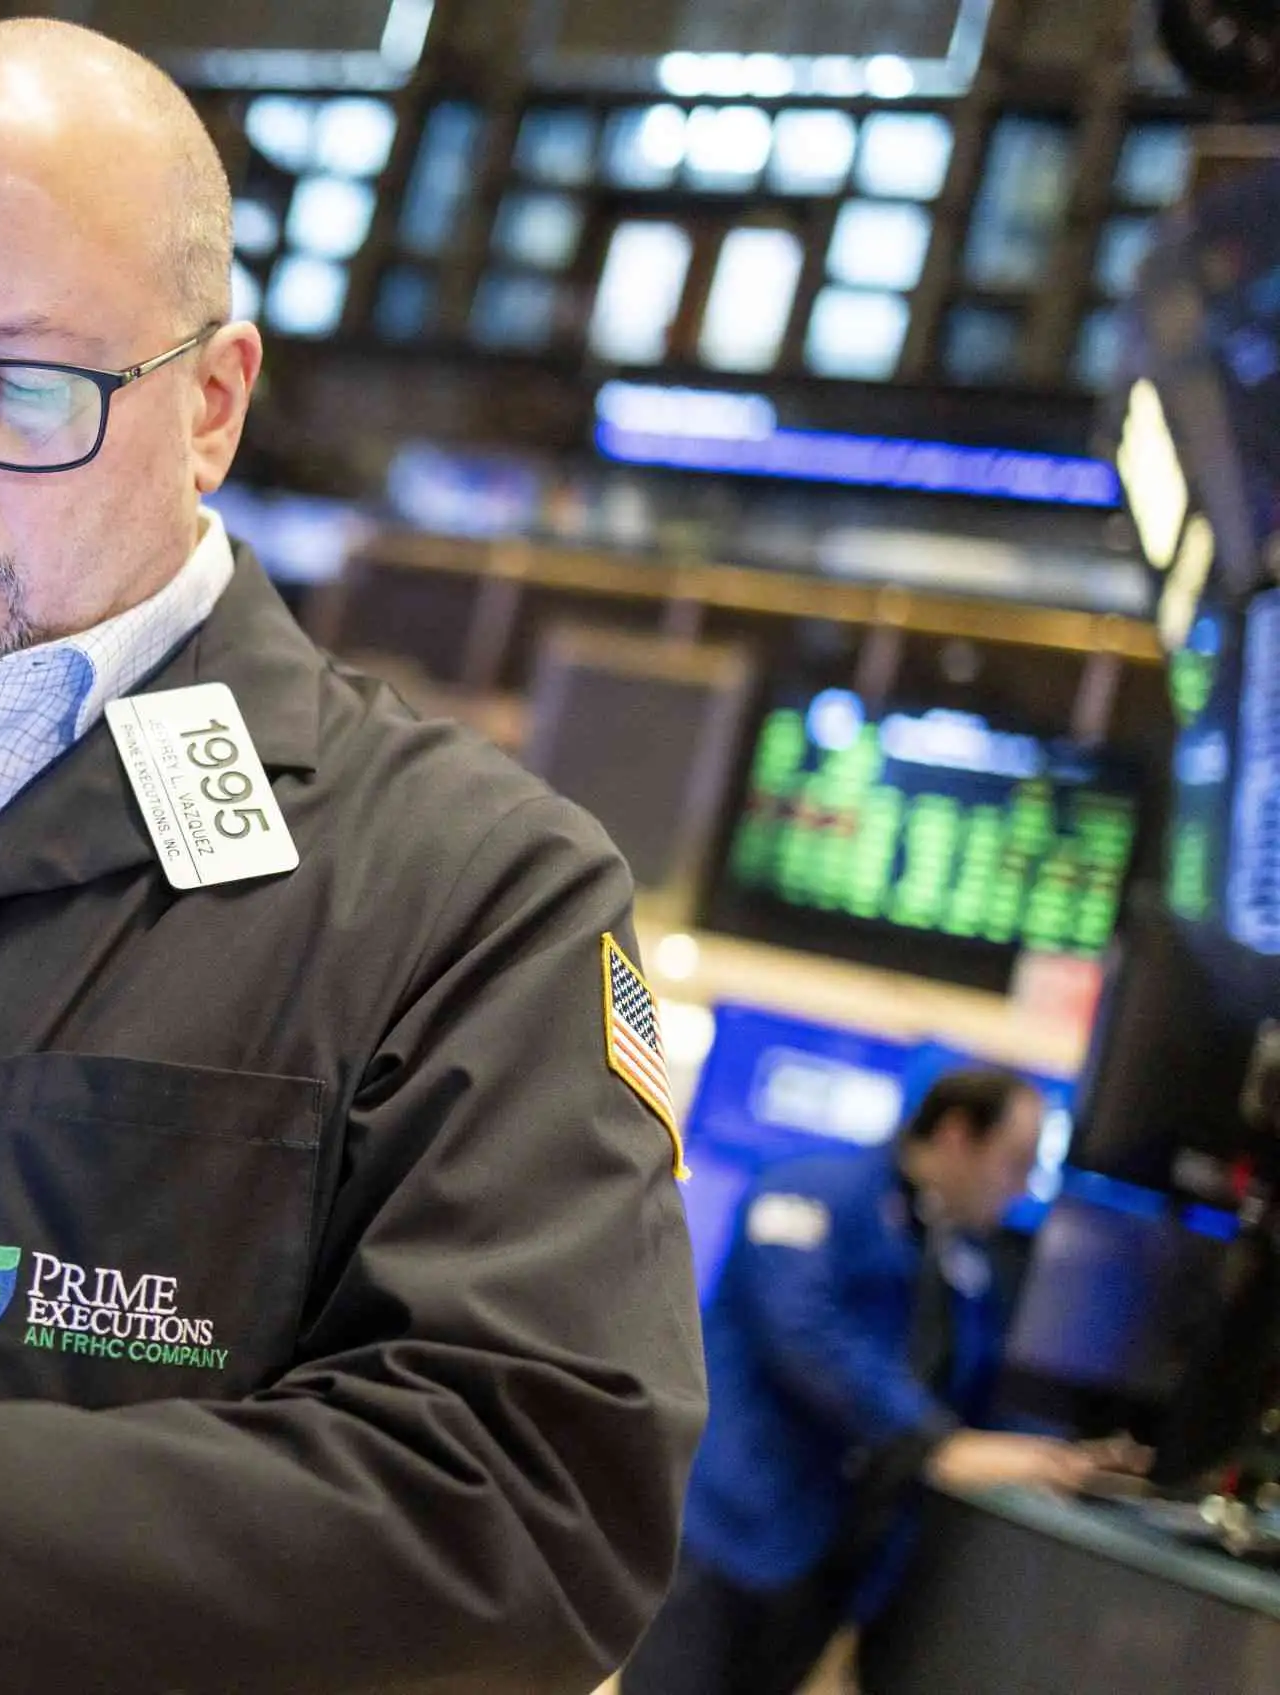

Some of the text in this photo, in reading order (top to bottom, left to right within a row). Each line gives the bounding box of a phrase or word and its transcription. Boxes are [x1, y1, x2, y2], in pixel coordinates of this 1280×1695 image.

[148, 718, 180, 767] JEREY
[179, 792, 215, 857] VAZQUEZ
[180, 718, 271, 839] 1995
[163, 838, 181, 862] INC.
[27, 1251, 177, 1315] PRIME
[24, 1325, 228, 1369] AN FRHC COMPANY
[27, 1297, 214, 1346] EXECUTIONS
